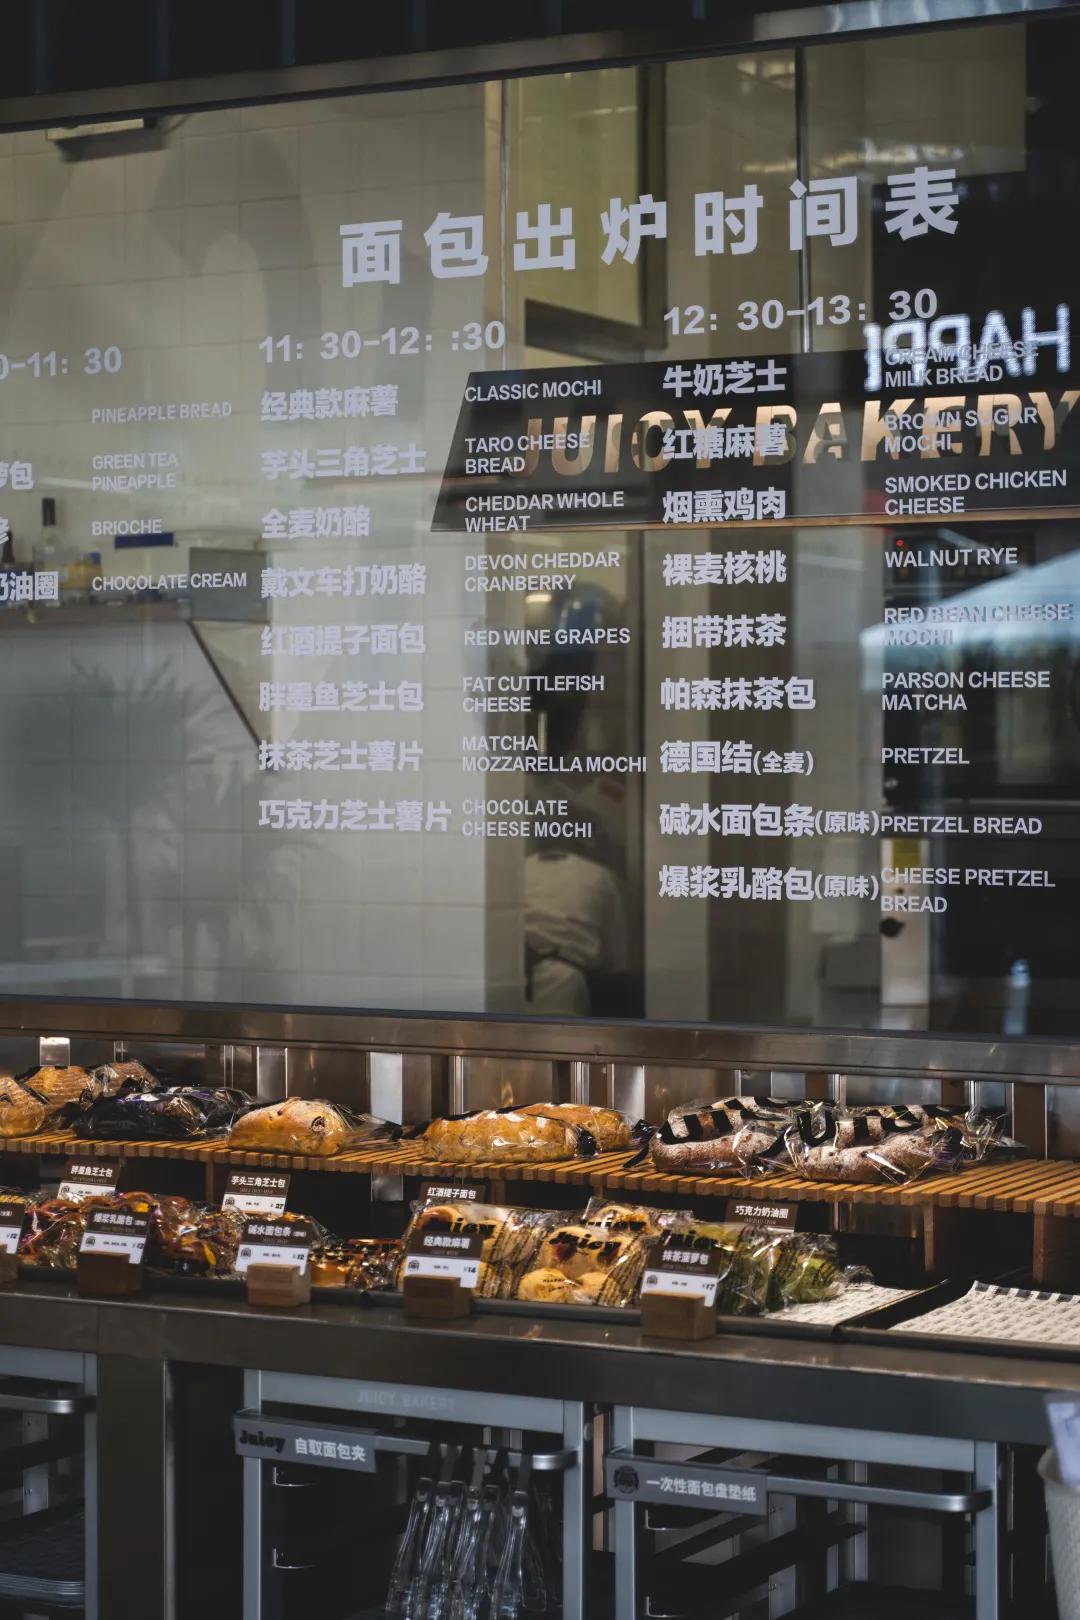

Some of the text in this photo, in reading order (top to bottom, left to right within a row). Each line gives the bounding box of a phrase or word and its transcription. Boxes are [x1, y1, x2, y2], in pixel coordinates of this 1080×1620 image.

[339, 166, 960, 287] 面包出炉时间表
[888, 288, 938, 321] 30
[84, 346, 122, 375] 30
[662, 359, 787, 398] 牛奶芝士
[885, 365, 1003, 388] MILK BREAD
[464, 379, 602, 402] CLASSIC MOCHI
[91, 401, 232, 424] PINEAPPLE BREAD
[260, 384, 399, 422] 经典款麻薯
[885, 406, 1039, 432] BROWN SUGAR
[465, 432, 591, 454] TARO CHEESE
[507, 389, 1080, 478] JUICY BAKERY
[662, 423, 787, 461] 红糖麻薯
[884, 434, 952, 454] MOCHI
[92, 452, 179, 470] GREEN TEA
[260, 443, 427, 480] 芋头三角芝士
[465, 456, 526, 474] BREAD
[91, 473, 176, 491] PINEAPPLE
[885, 469, 1067, 494] SMOKED CHICKEN
[465, 490, 625, 513] CHEDDAR WHOLE
[662, 486, 787, 524] 烟熏鸡肉
[885, 496, 965, 516] CHEESE
[91, 518, 163, 536] BRIOCHE
[260, 504, 371, 539] 全麦奶酪
[465, 515, 531, 533] WHEAT
[464, 551, 621, 571] DEVON CHEDDAR
[662, 550, 787, 587] 裸麦核桃
[885, 547, 1018, 568] WALNUT RYE
[91, 572, 247, 591] CHOCOLATE CREAM
[260, 563, 427, 599] 戴文车打奶酪
[464, 574, 577, 592] CRANBERRY
[884, 603, 1074, 625] RED BEAN CHEESE
[260, 623, 427, 657] 红酒提子面包
[463, 627, 631, 646] RED WINE GRAPES
[662, 613, 787, 649] 捆带抹茶
[884, 628, 954, 647] MOCHI
[462, 675, 605, 692] FAT CUTTLEFISH
[881, 670, 1051, 689] PARSON CHEESE
[259, 680, 424, 712] 胖墨鱼芝士包
[462, 696, 531, 713] CHEESE
[660, 676, 817, 711] 帕森抹茶包
[881, 693, 968, 711] MATCHA
[462, 735, 539, 751] MATCHA
[258, 740, 424, 772] 抹茶芝士薯片
[462, 756, 647, 773] MOZZARELLA MOCHI
[881, 747, 970, 765] PRETZEL
[258, 799, 452, 832] 巧克力芝士薯片
[462, 799, 569, 816] CHOCOLATE
[462, 821, 593, 839] CHEESE MOCHI
[881, 815, 1043, 835] PRETZEL BREAD
[881, 867, 1056, 887] CHEESE PRETZEL
[881, 895, 948, 914] BREAD
[231, 1175, 286, 1189] 芋头三角芝士包
[294, 1437, 367, 1463] 自取面包夹
[646, 1476, 757, 1502] 一次性面包盘垫纸
